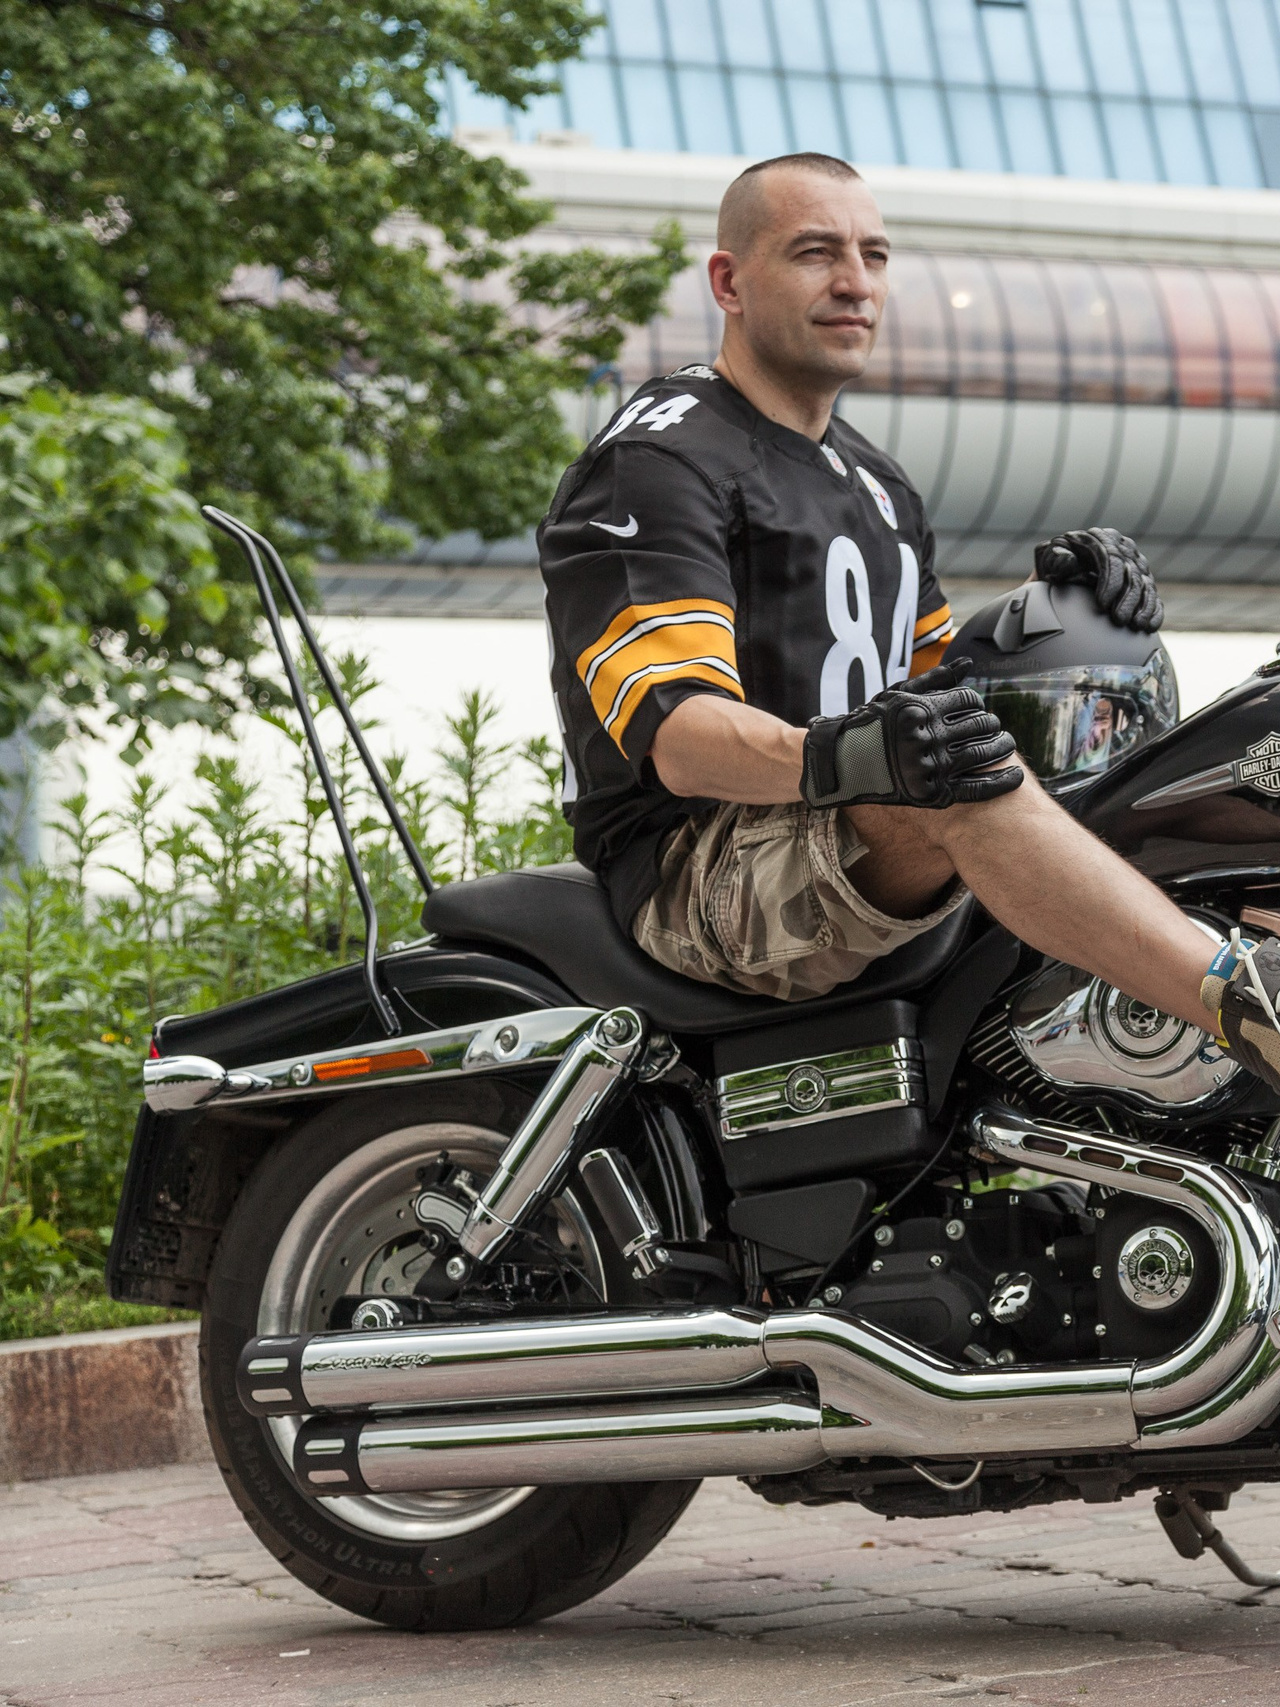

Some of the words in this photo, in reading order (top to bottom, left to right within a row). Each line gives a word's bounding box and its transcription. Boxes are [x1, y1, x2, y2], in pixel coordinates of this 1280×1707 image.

[598, 393, 700, 447] 84
[820, 535, 920, 717] 84
[333, 1541, 413, 1576] ULTRA
